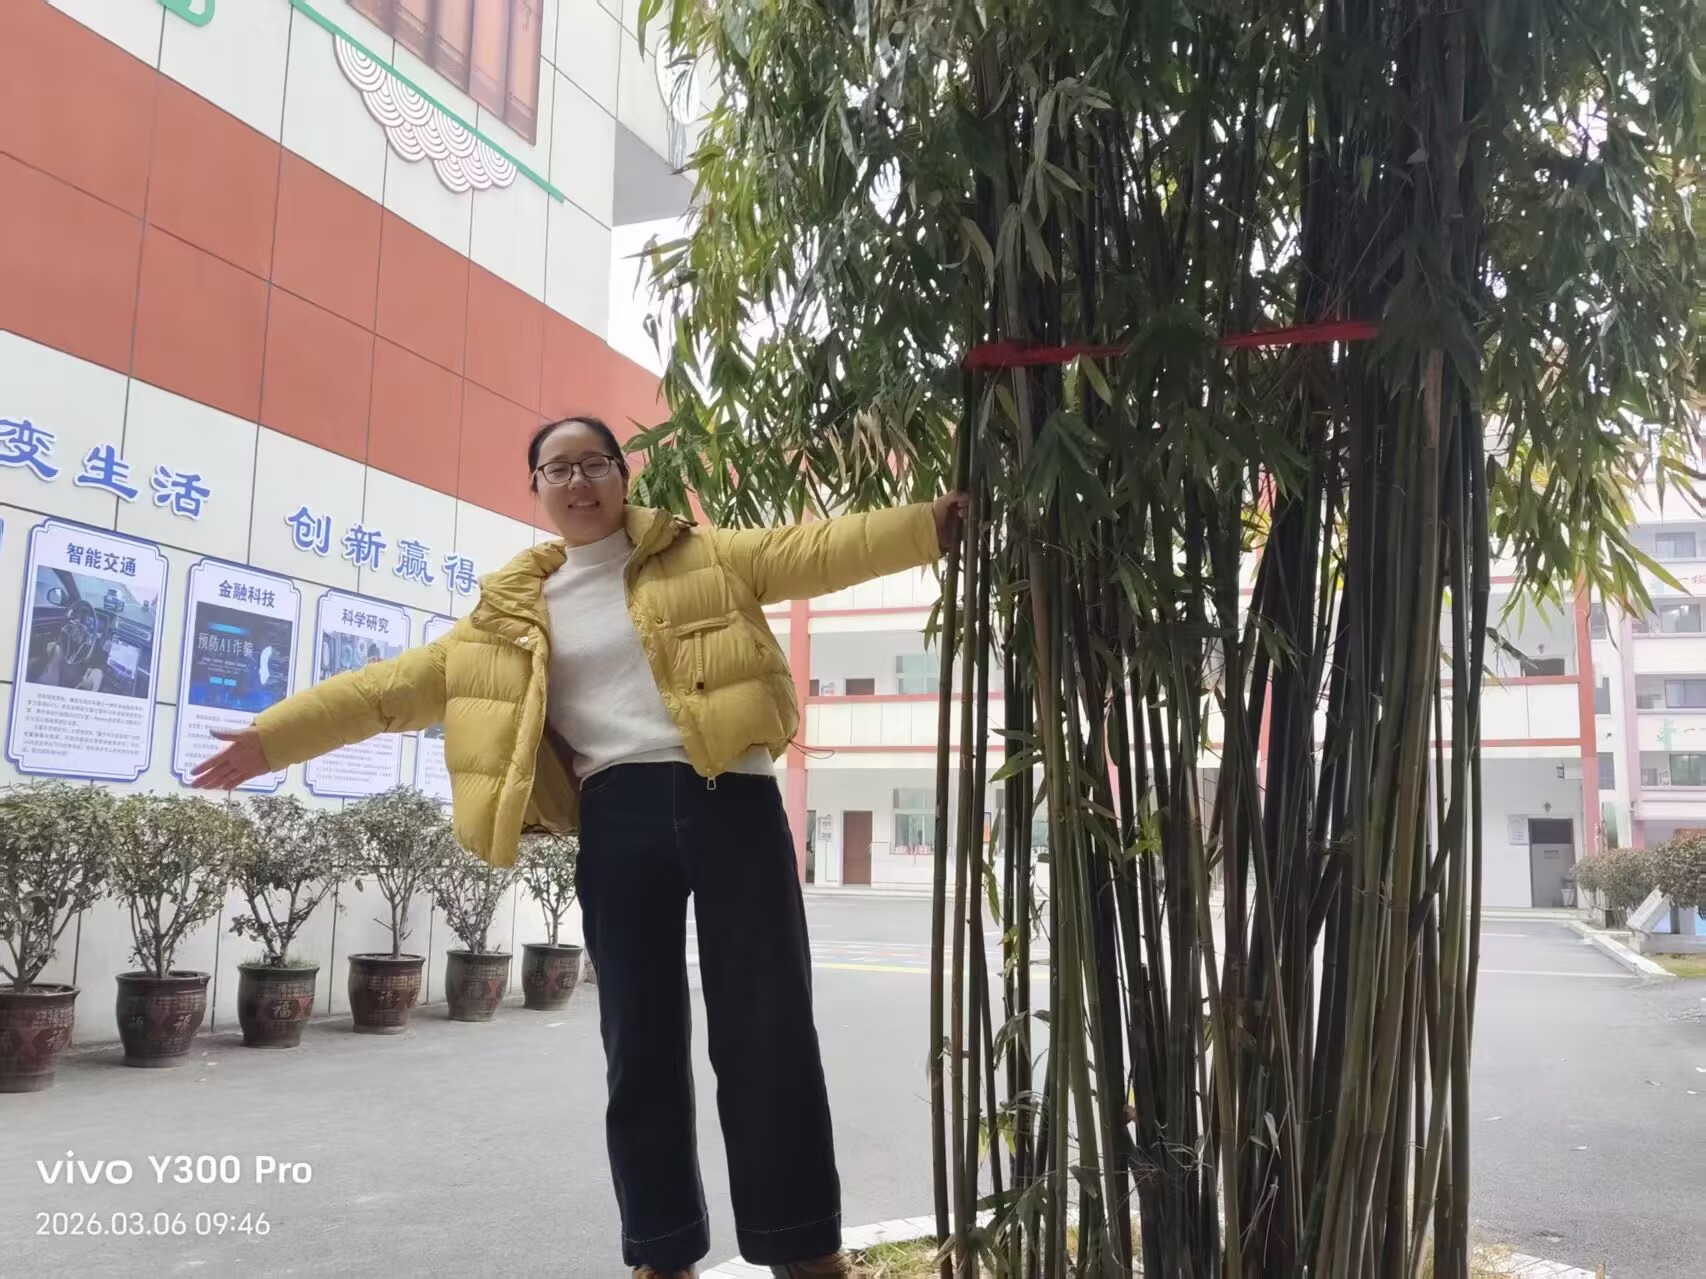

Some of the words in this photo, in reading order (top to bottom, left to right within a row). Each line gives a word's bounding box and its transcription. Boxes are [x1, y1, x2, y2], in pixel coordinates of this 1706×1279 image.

[0, 417, 212, 518] 变生活
[285, 504, 479, 595] 创新赢得
[66, 542, 136, 577] 智能交通
[218, 579, 276, 608] 金融科技
[341, 608, 390, 634] 科学研究
[197, 632, 254, 657] 预防AI诈骗
